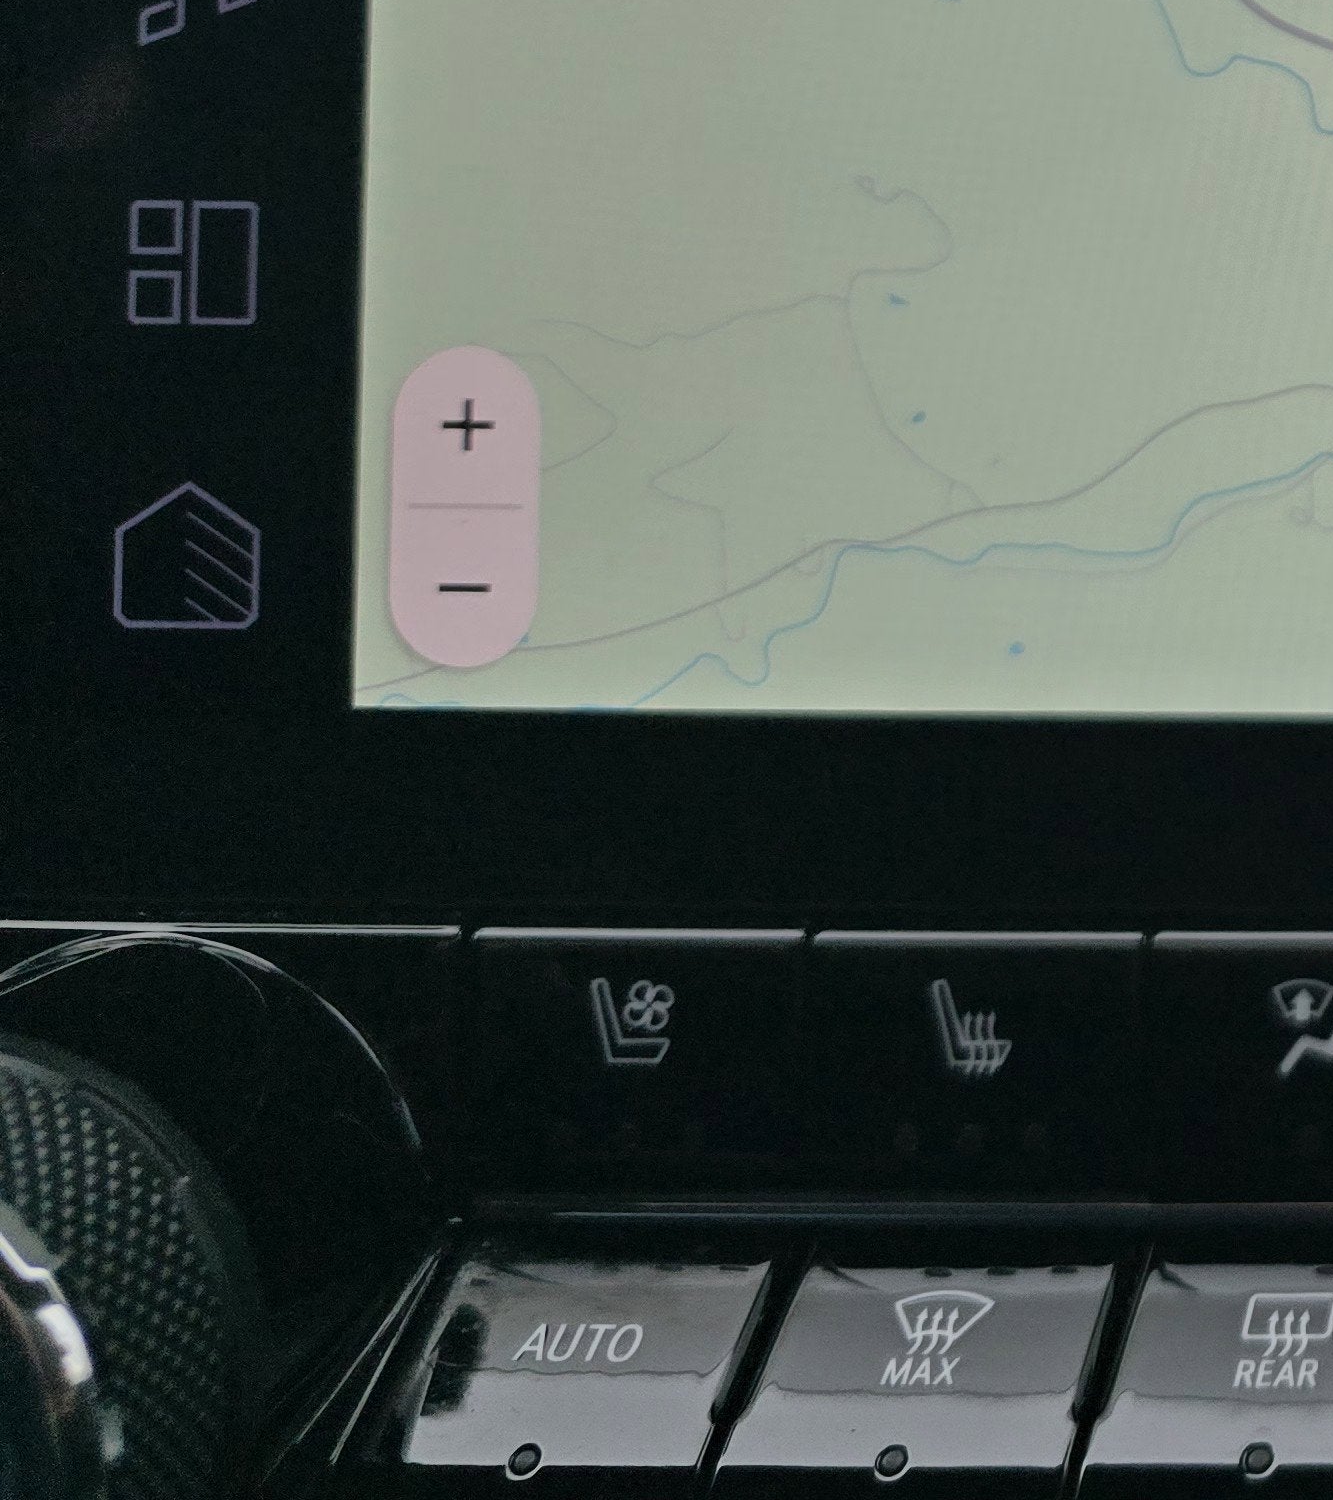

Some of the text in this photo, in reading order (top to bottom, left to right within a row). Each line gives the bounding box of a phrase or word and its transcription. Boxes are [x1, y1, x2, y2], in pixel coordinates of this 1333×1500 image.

[514, 1323, 644, 1364] AUTO
[881, 1355, 961, 1386] MAX
[1233, 1358, 1319, 1390] REAR
